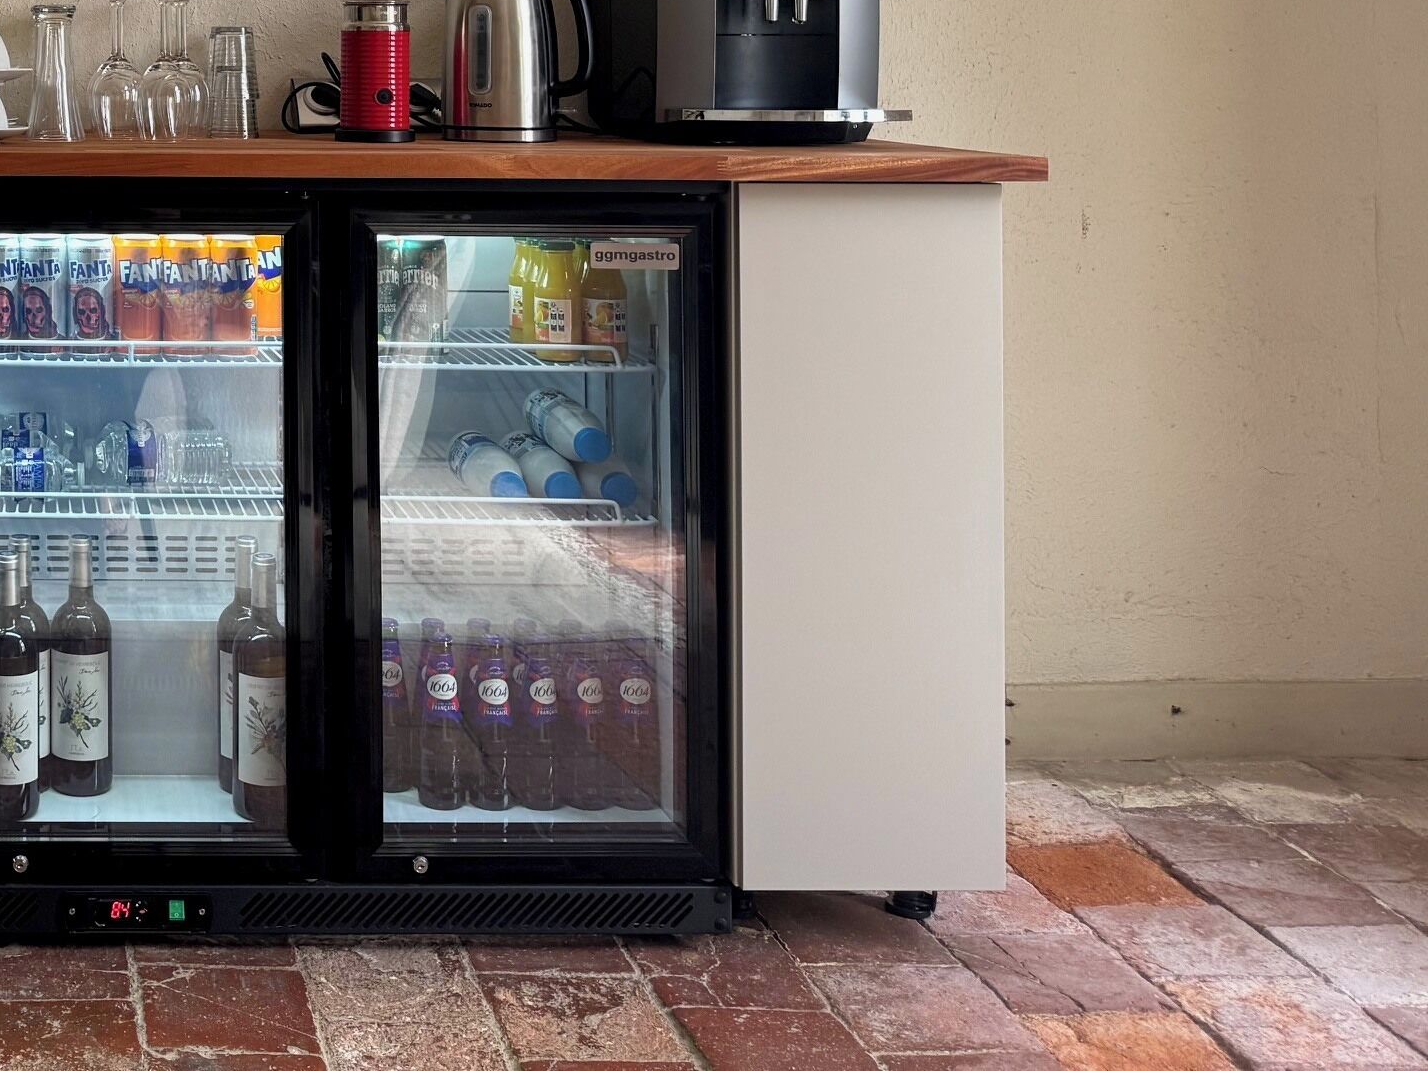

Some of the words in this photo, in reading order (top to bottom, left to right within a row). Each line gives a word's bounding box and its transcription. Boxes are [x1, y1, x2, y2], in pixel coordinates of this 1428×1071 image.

[594, 249, 676, 263] ggmgastro
[69, 259, 112, 279] FANTA
[119, 257, 162, 284] FANT
[163, 257, 210, 284] FANT
[211, 257, 256, 283] ANTA
[402, 266, 439, 290] errier
[429, 680, 456, 693] 1664
[481, 685, 507, 698] 1664
[581, 686, 601, 697] 166
[622, 686, 649, 697] 1664
